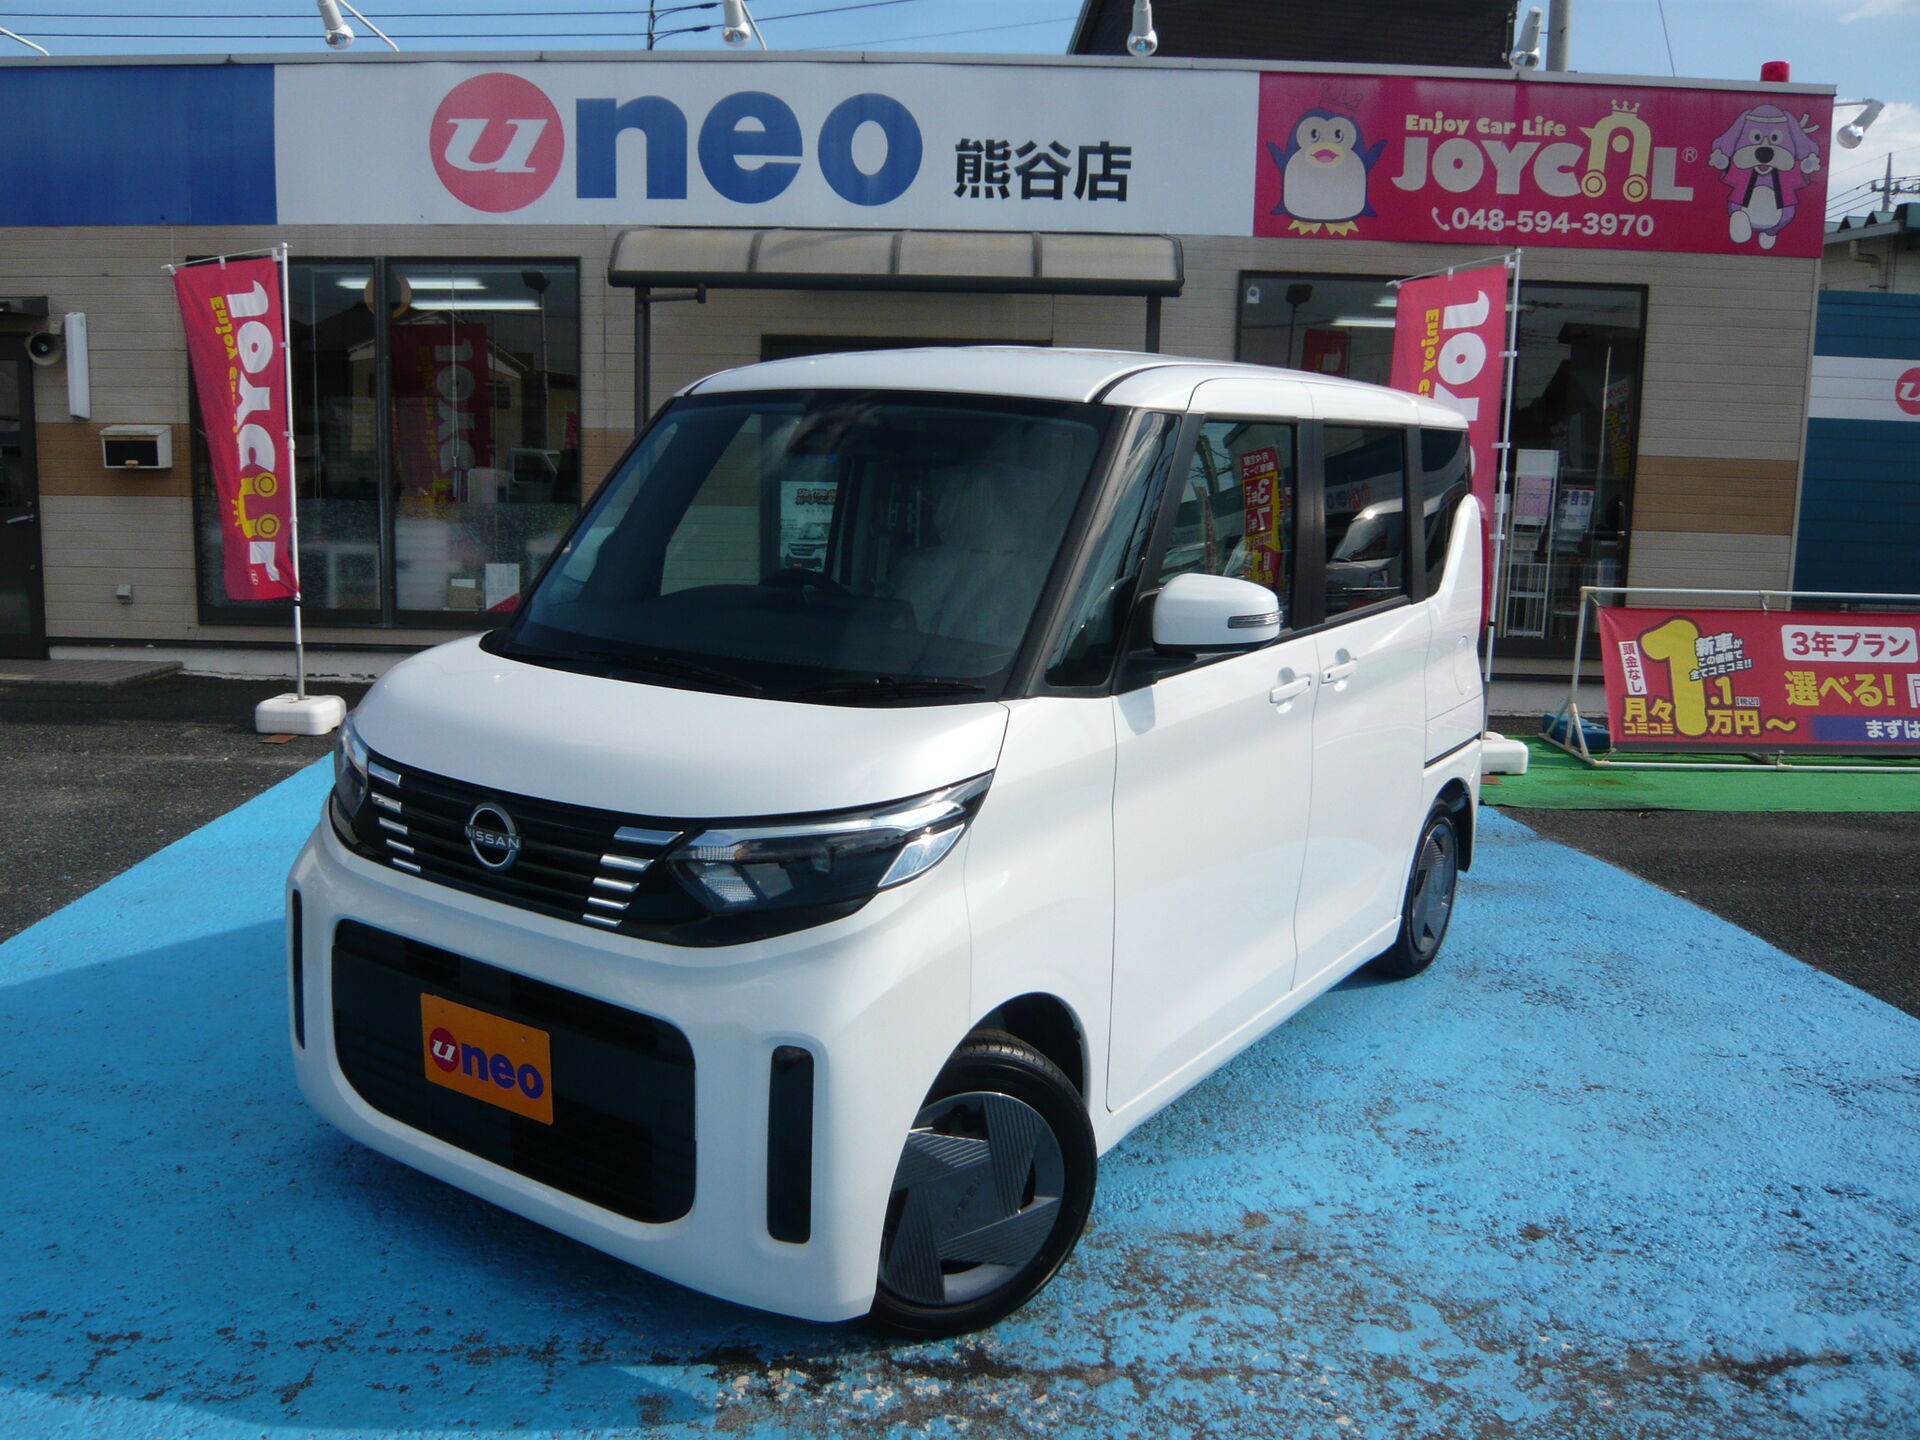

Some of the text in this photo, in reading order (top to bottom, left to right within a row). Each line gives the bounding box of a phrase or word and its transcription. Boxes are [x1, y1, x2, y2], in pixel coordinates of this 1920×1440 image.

[1406, 111, 1568, 136] Enjoy Car Life
[954, 138, 1132, 202] 熊谷店
[1452, 207, 1654, 236] 048-594-3970
[1791, 631, 1910, 657] 3年プラン
[1622, 643, 1643, 692] 頭金なし
[1784, 670, 1896, 707] 選べる!
[1624, 698, 1673, 722] 月々
[1624, 723, 1674, 735] コミコミ
[465, 825, 520, 849] NISSAN
